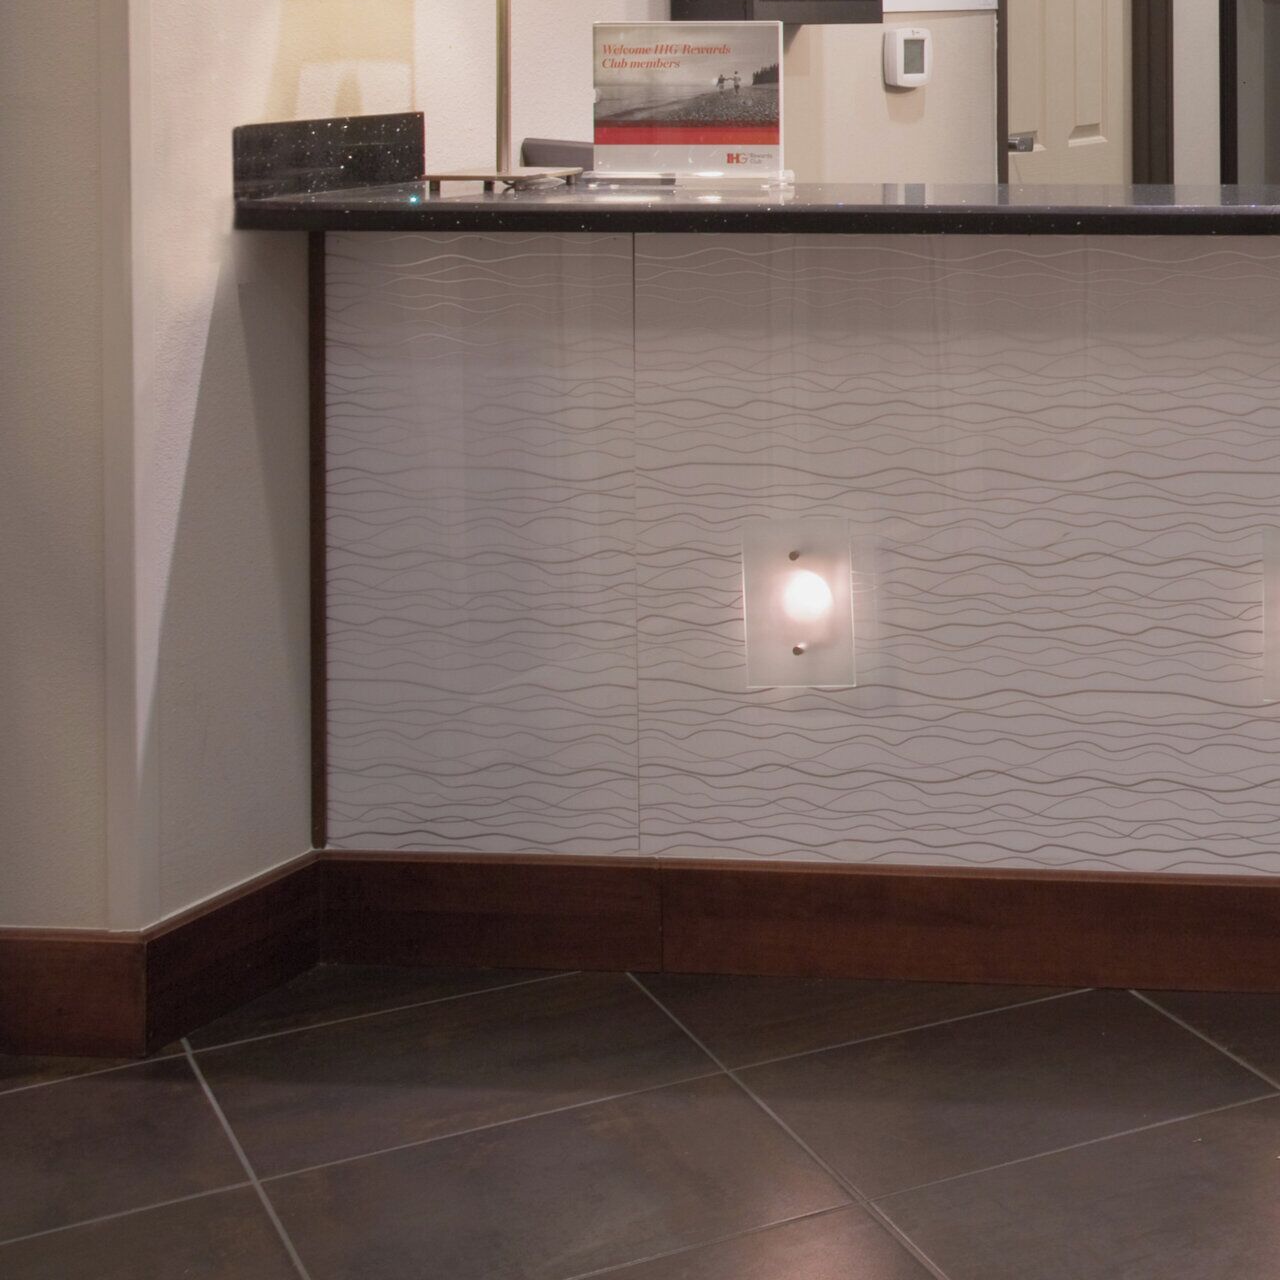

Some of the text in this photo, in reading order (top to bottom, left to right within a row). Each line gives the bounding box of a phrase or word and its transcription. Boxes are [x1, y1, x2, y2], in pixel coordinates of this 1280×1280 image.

[601, 43, 652, 56] Welcome
[682, 43, 732, 56] Rewards
[601, 57, 681, 69] Club members
[727, 152, 748, 165] IHG
